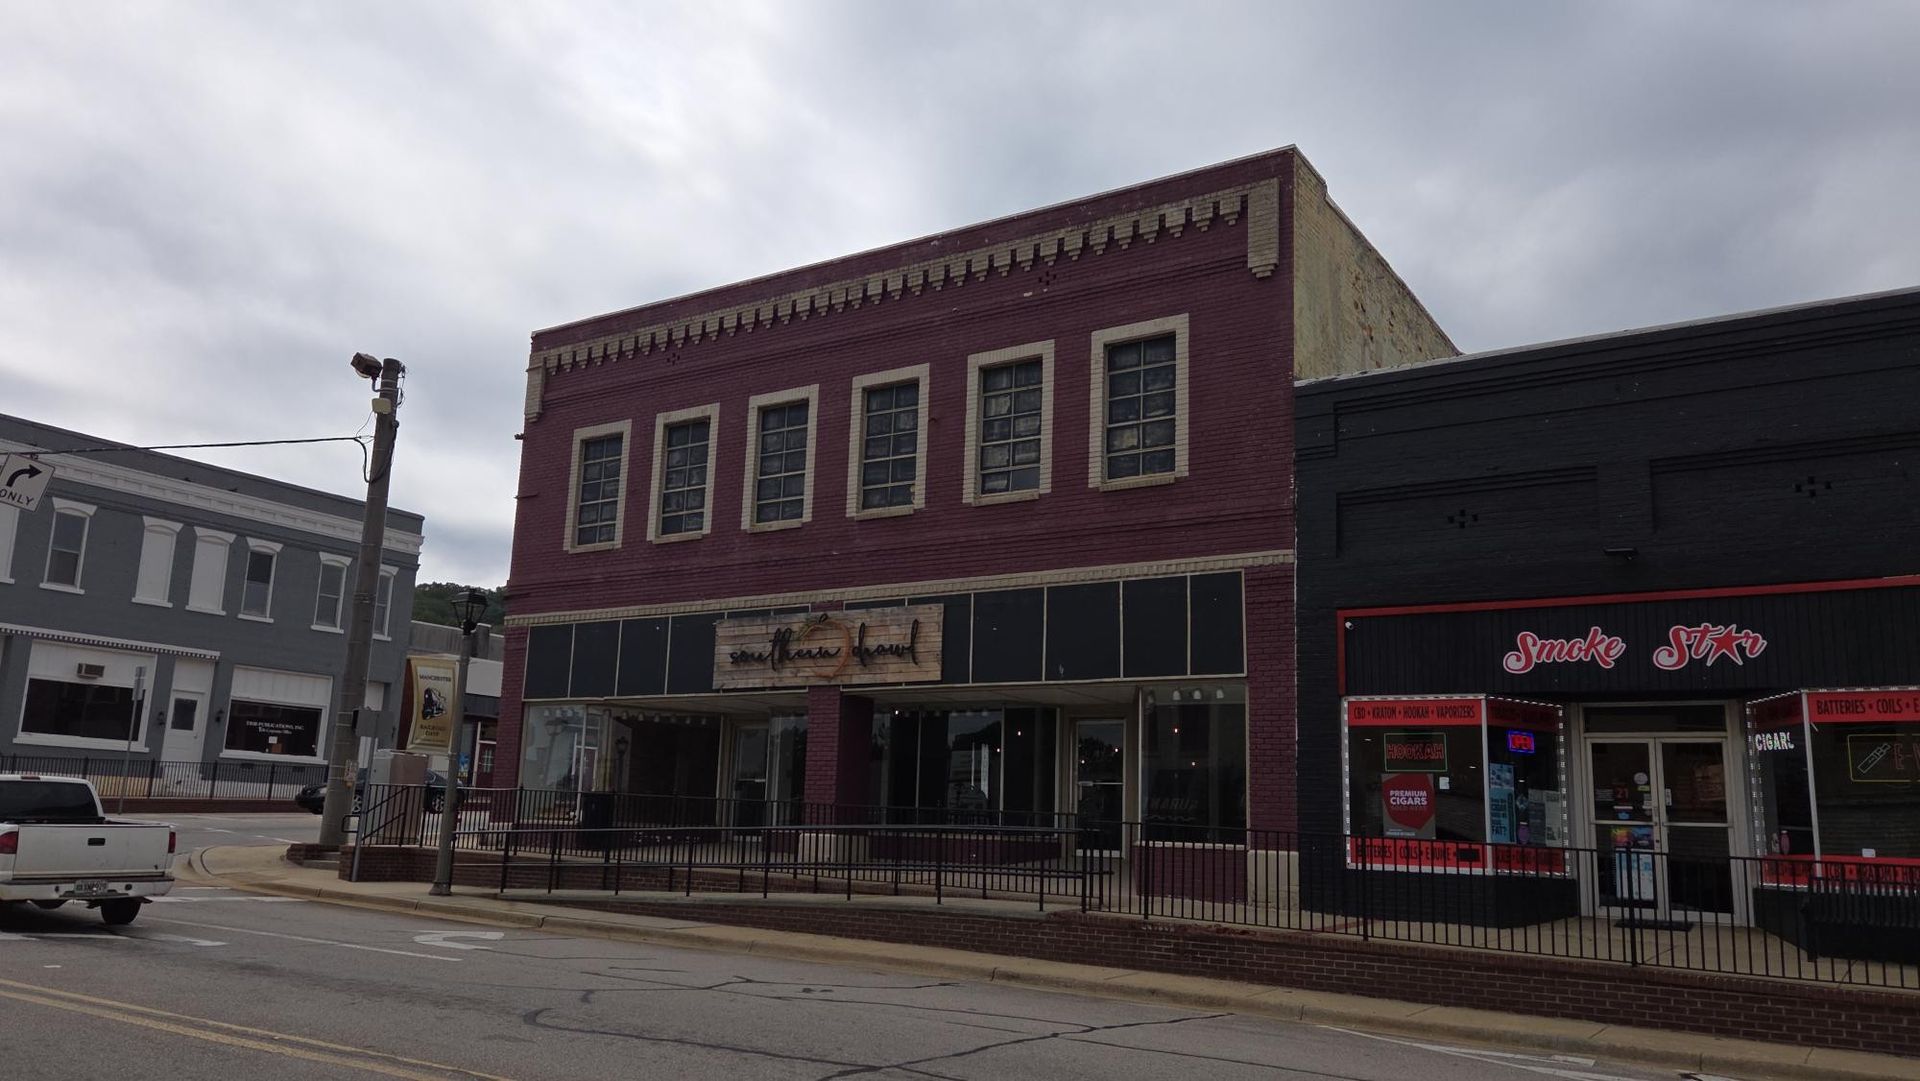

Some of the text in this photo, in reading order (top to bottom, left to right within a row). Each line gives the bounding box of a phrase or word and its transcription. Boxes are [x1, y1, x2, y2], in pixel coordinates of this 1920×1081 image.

[0, 488, 34, 506] ONLY
[729, 619, 919, 671] southern drawl
[1503, 626, 1627, 674] Smoke
[1353, 706, 1366, 720] CBD
[1372, 705, 1397, 720] KRATOM
[1402, 705, 1430, 719] HOOKAH
[1435, 704, 1476, 719] VAPORIZERS
[1816, 699, 1866, 715] BATTERIES
[1876, 698, 1903, 714] COILS
[1386, 743, 1445, 760] HOOKAH
[1390, 797, 1428, 805] CIGARS
